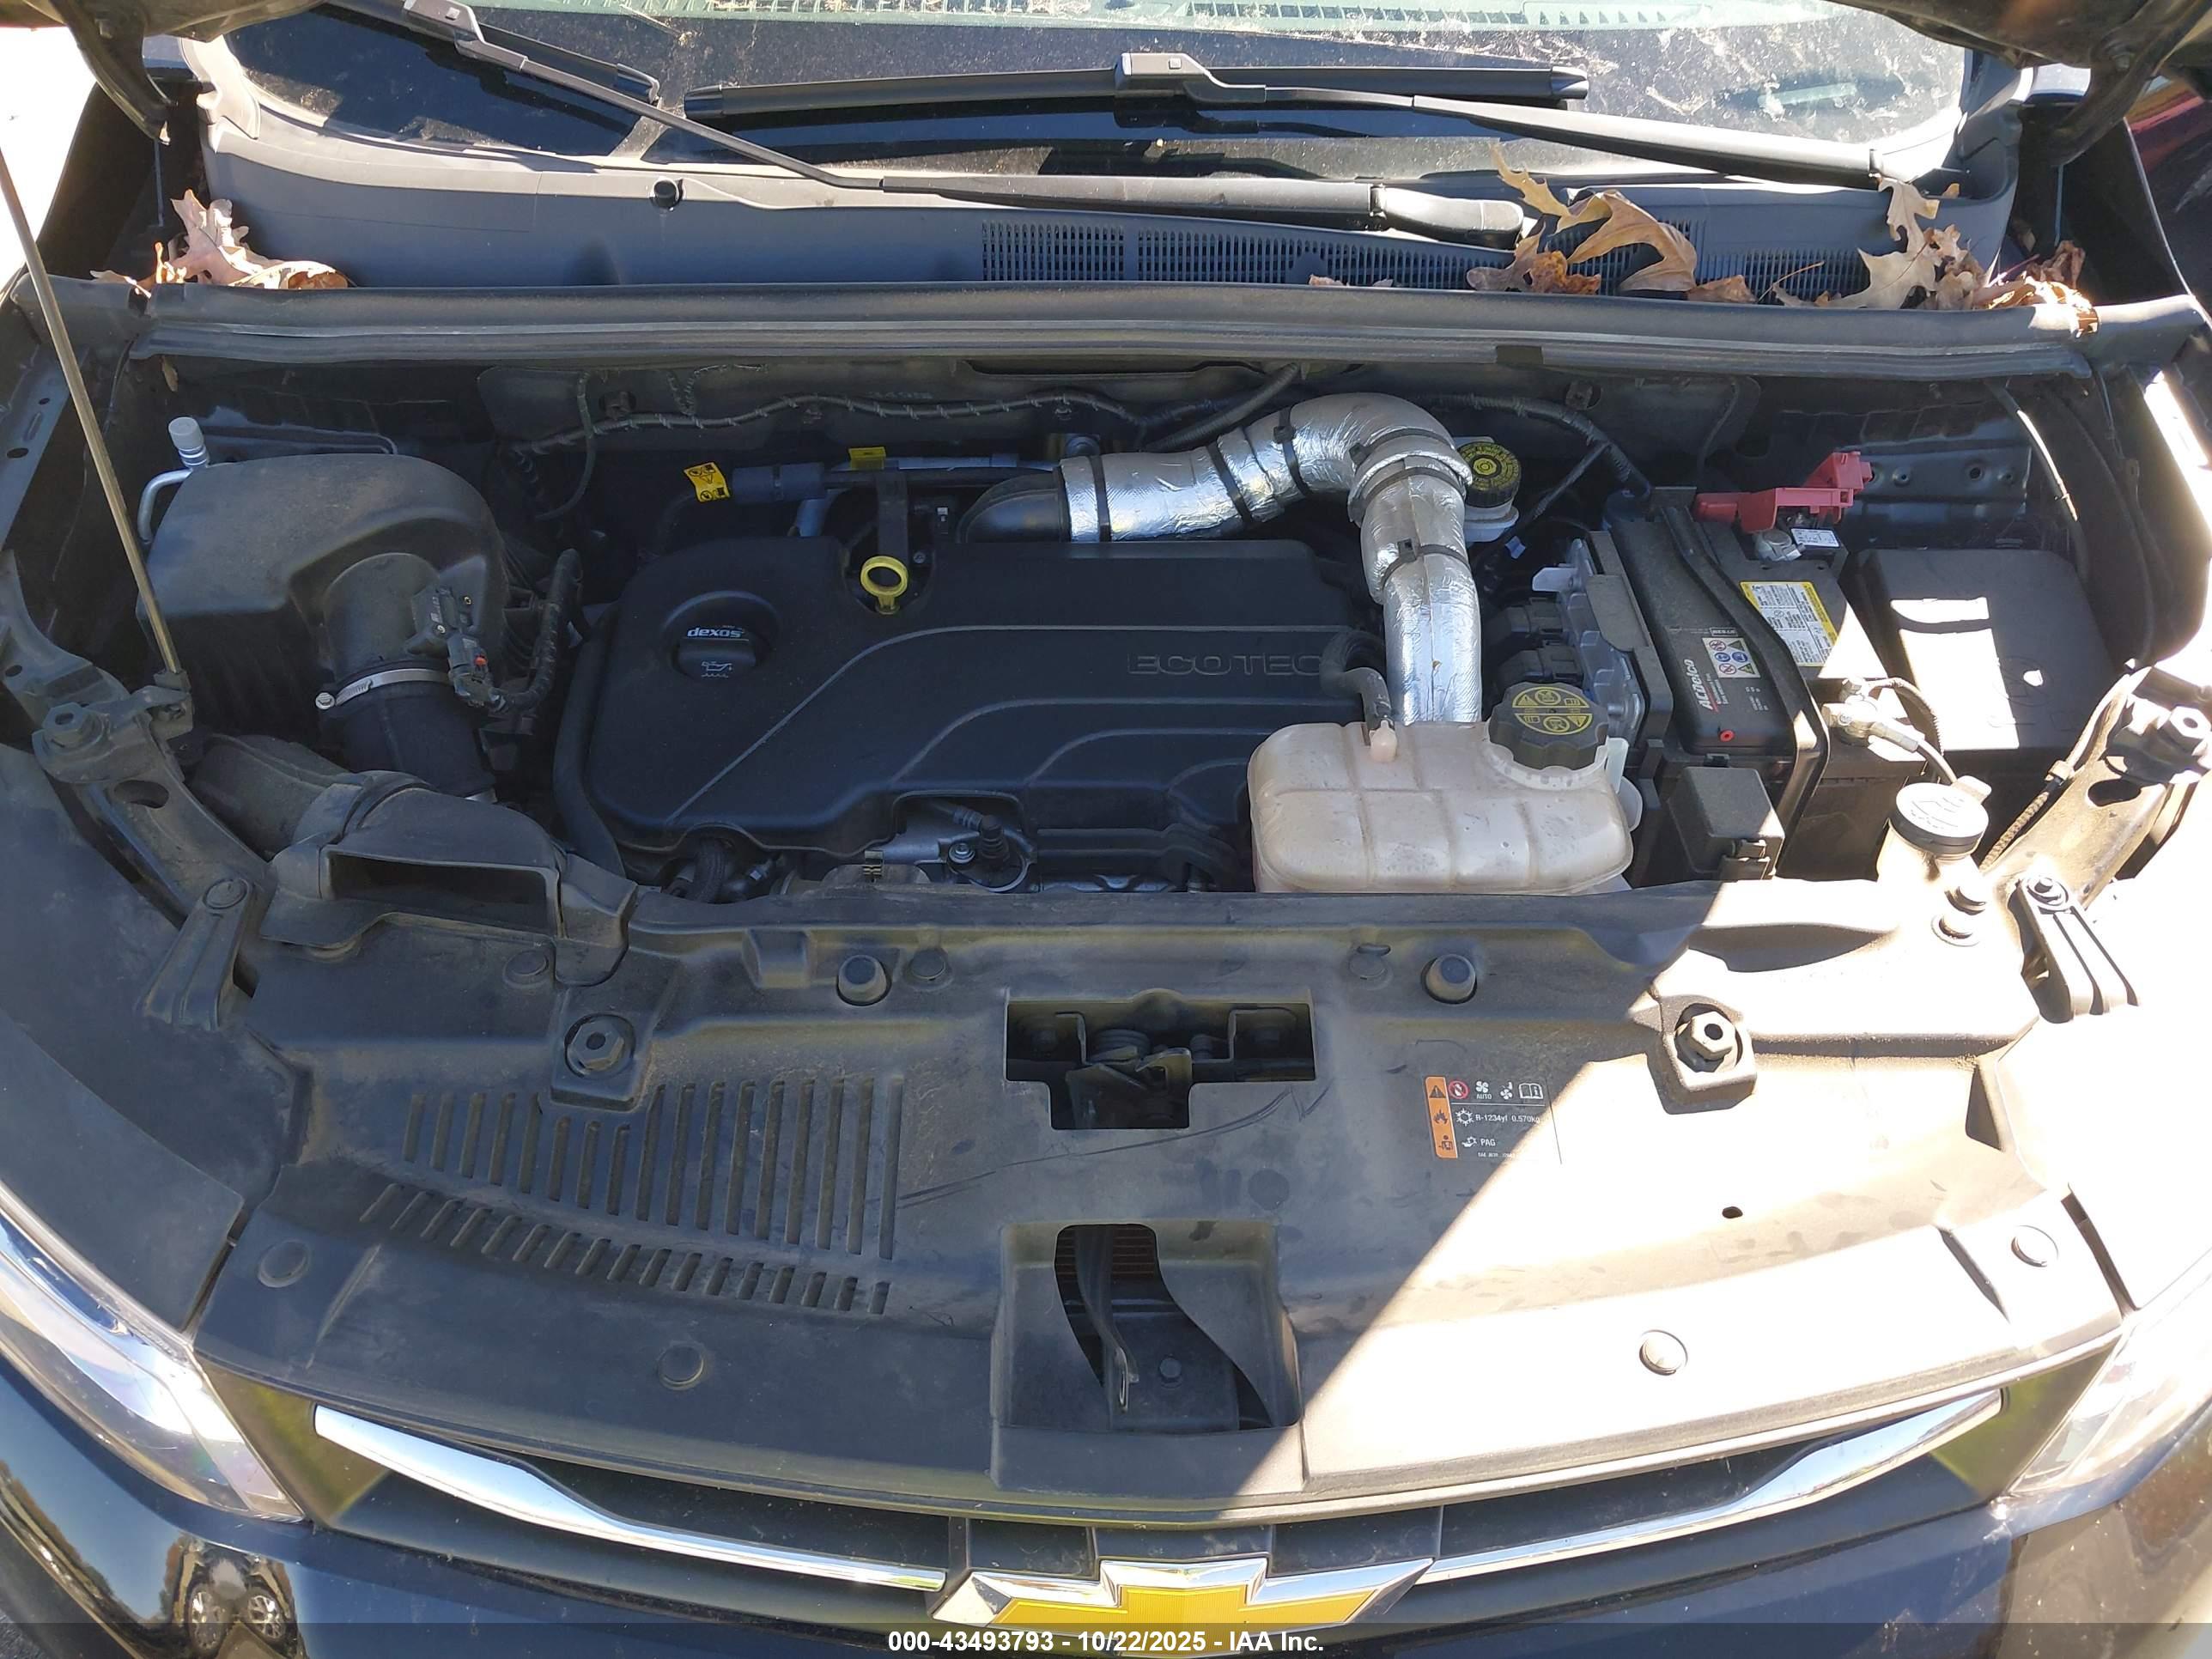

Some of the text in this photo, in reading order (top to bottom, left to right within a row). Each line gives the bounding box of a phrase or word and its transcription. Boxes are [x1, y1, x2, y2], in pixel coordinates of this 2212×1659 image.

[687, 627, 742, 638] dexos
[1127, 653, 1321, 676] ECOTEC
[1684, 659, 1714, 711] ACDelco
